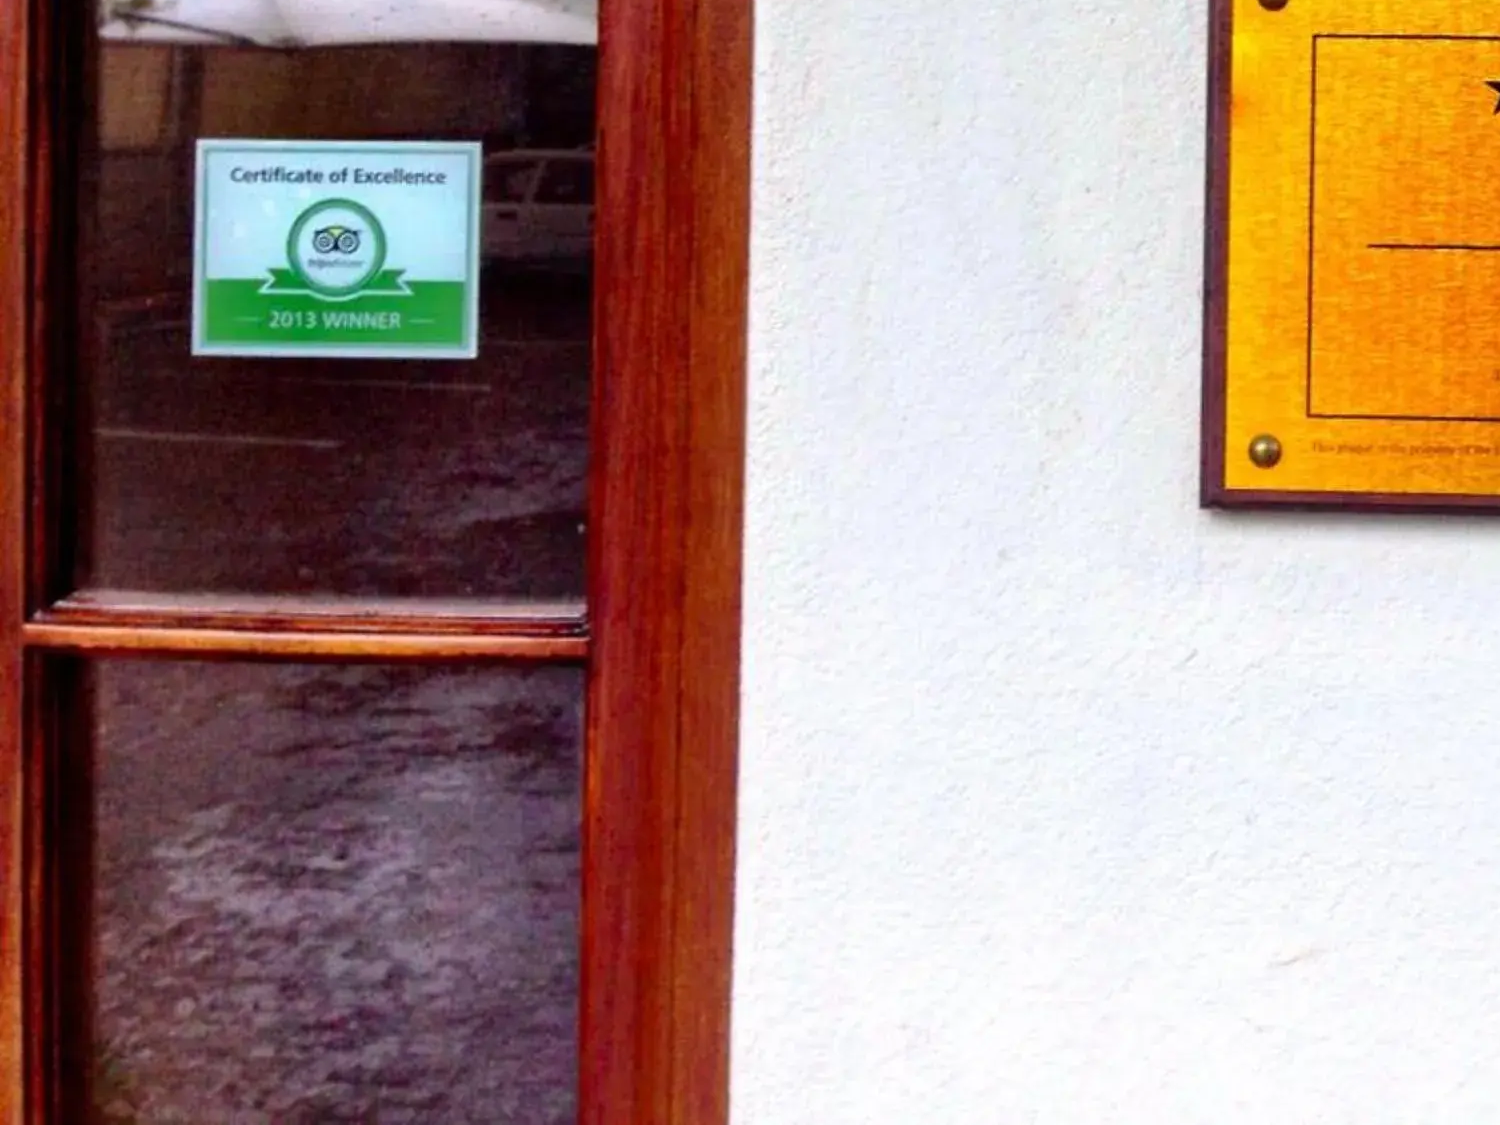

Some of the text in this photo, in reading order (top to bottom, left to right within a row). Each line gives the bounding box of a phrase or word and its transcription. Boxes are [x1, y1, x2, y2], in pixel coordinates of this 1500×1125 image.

[229, 166, 447, 186] Certificate of Excellence
[269, 310, 401, 329] 2013 WINNER
